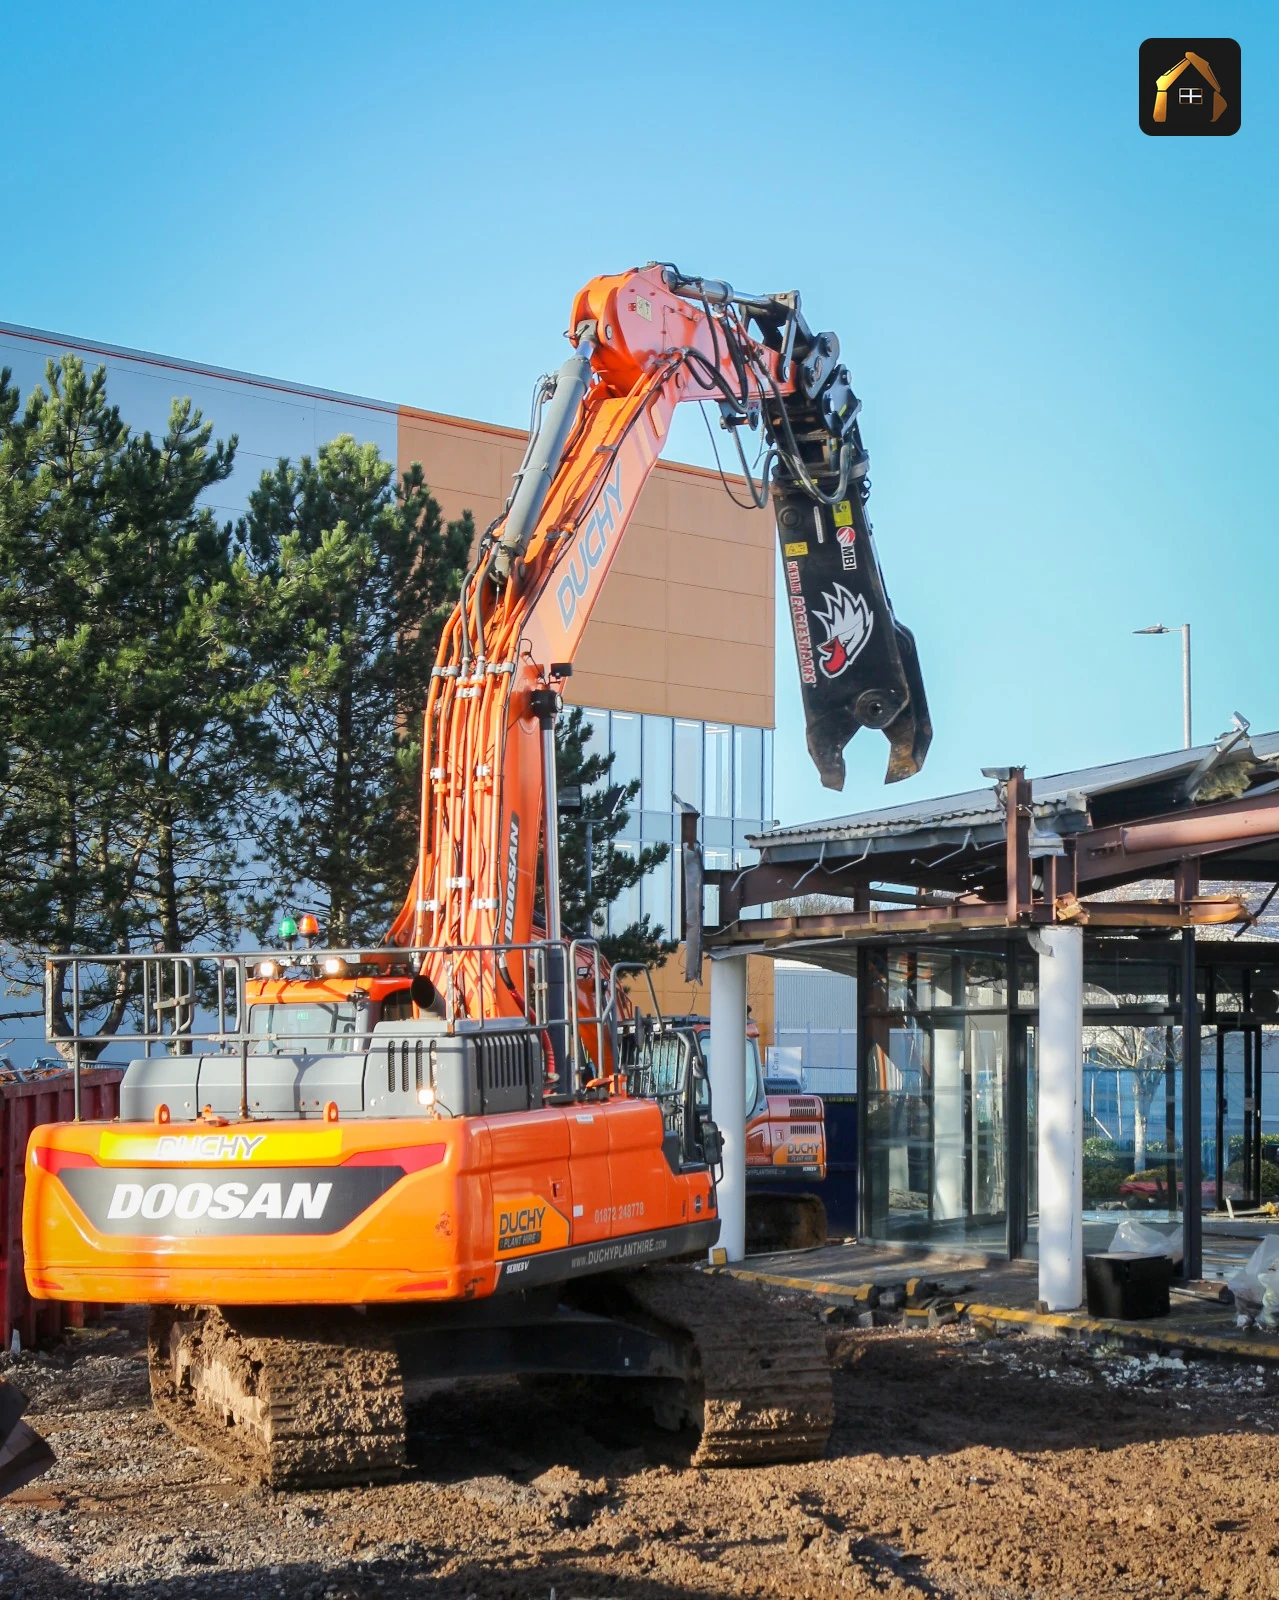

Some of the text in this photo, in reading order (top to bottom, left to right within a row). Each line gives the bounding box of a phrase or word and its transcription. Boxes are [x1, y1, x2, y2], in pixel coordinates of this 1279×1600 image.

[556, 460, 623, 632] DUCHY
[842, 545, 856, 569] MBI
[504, 822, 519, 940] DOOSAN
[157, 1134, 267, 1159] DUCHY
[787, 1142, 820, 1154] DUCHY
[107, 1182, 333, 1220] DOOSAN
[594, 1201, 645, 1224] 01872 248778
[500, 1206, 546, 1235] DUCHY
[503, 1232, 536, 1248] PLANT HIRE
